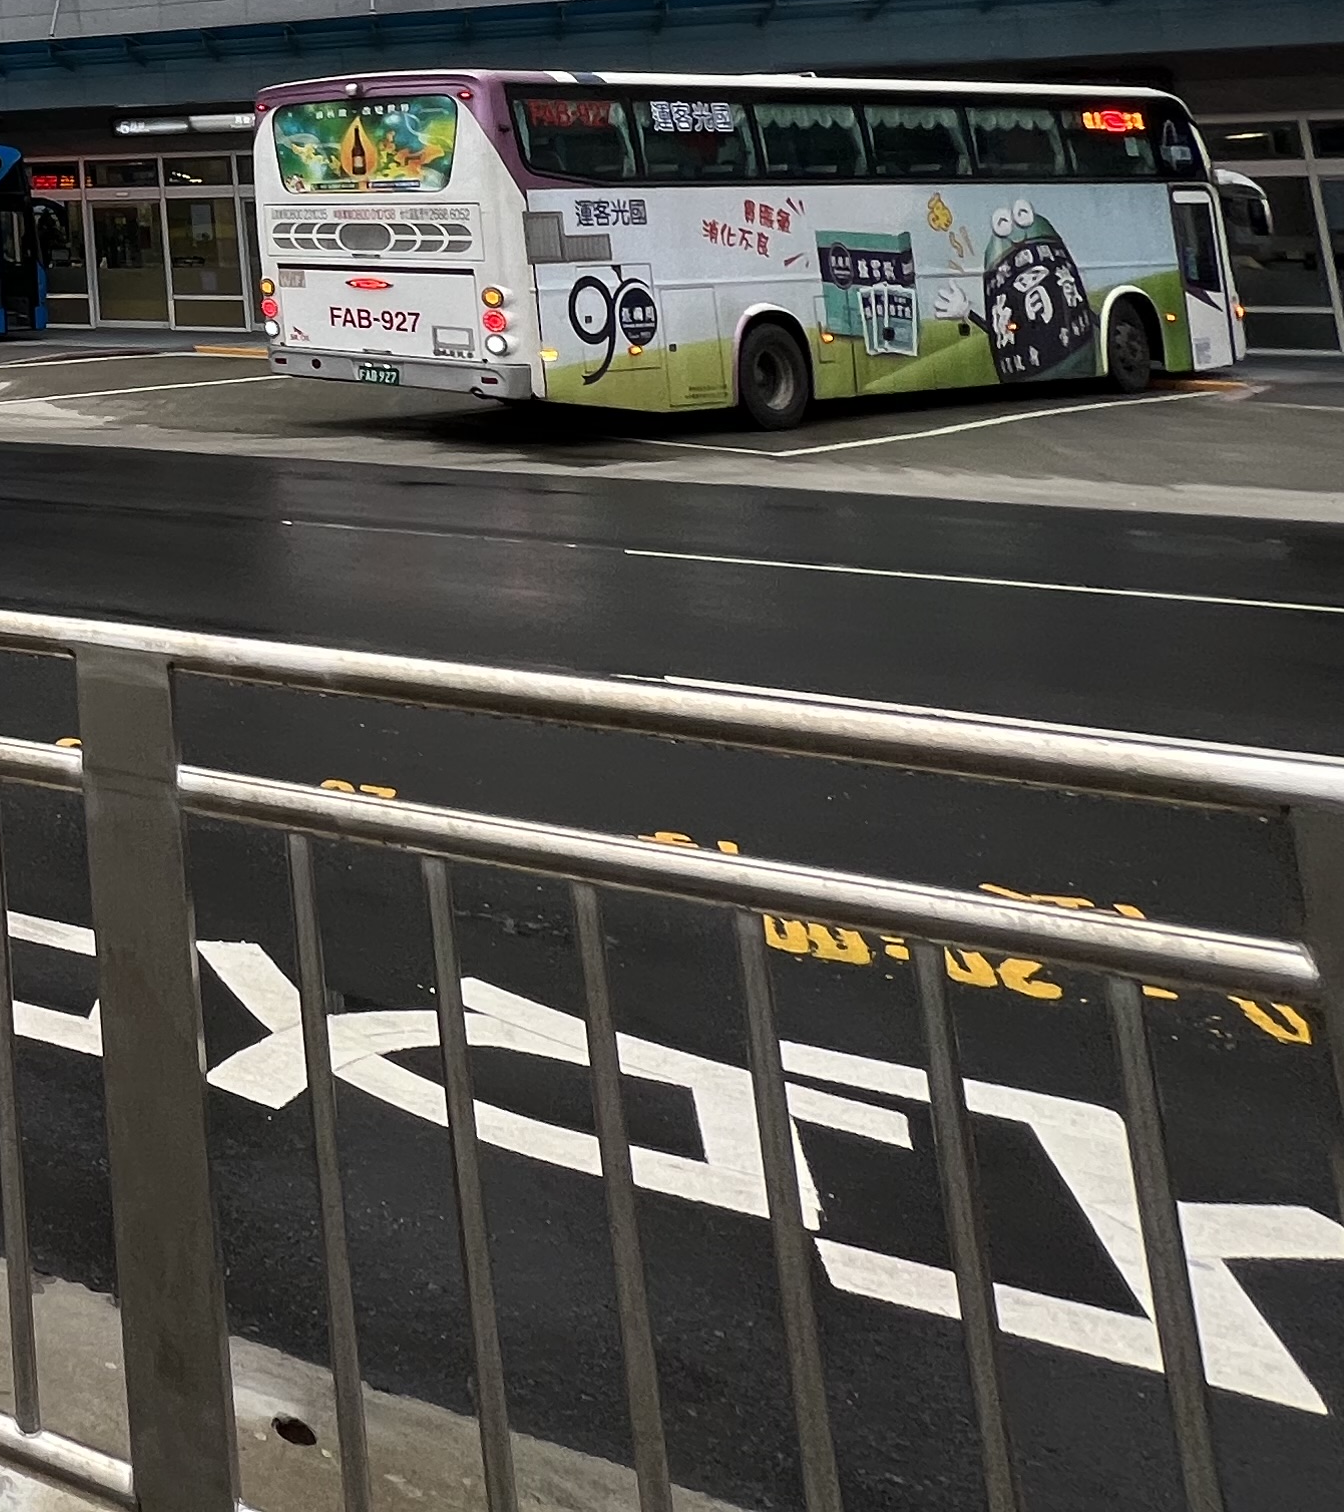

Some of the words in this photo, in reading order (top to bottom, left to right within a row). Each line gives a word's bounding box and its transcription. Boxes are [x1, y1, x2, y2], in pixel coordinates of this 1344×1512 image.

[702, 219, 770, 258] 消化不良
[329, 306, 421, 332] FAB-927
